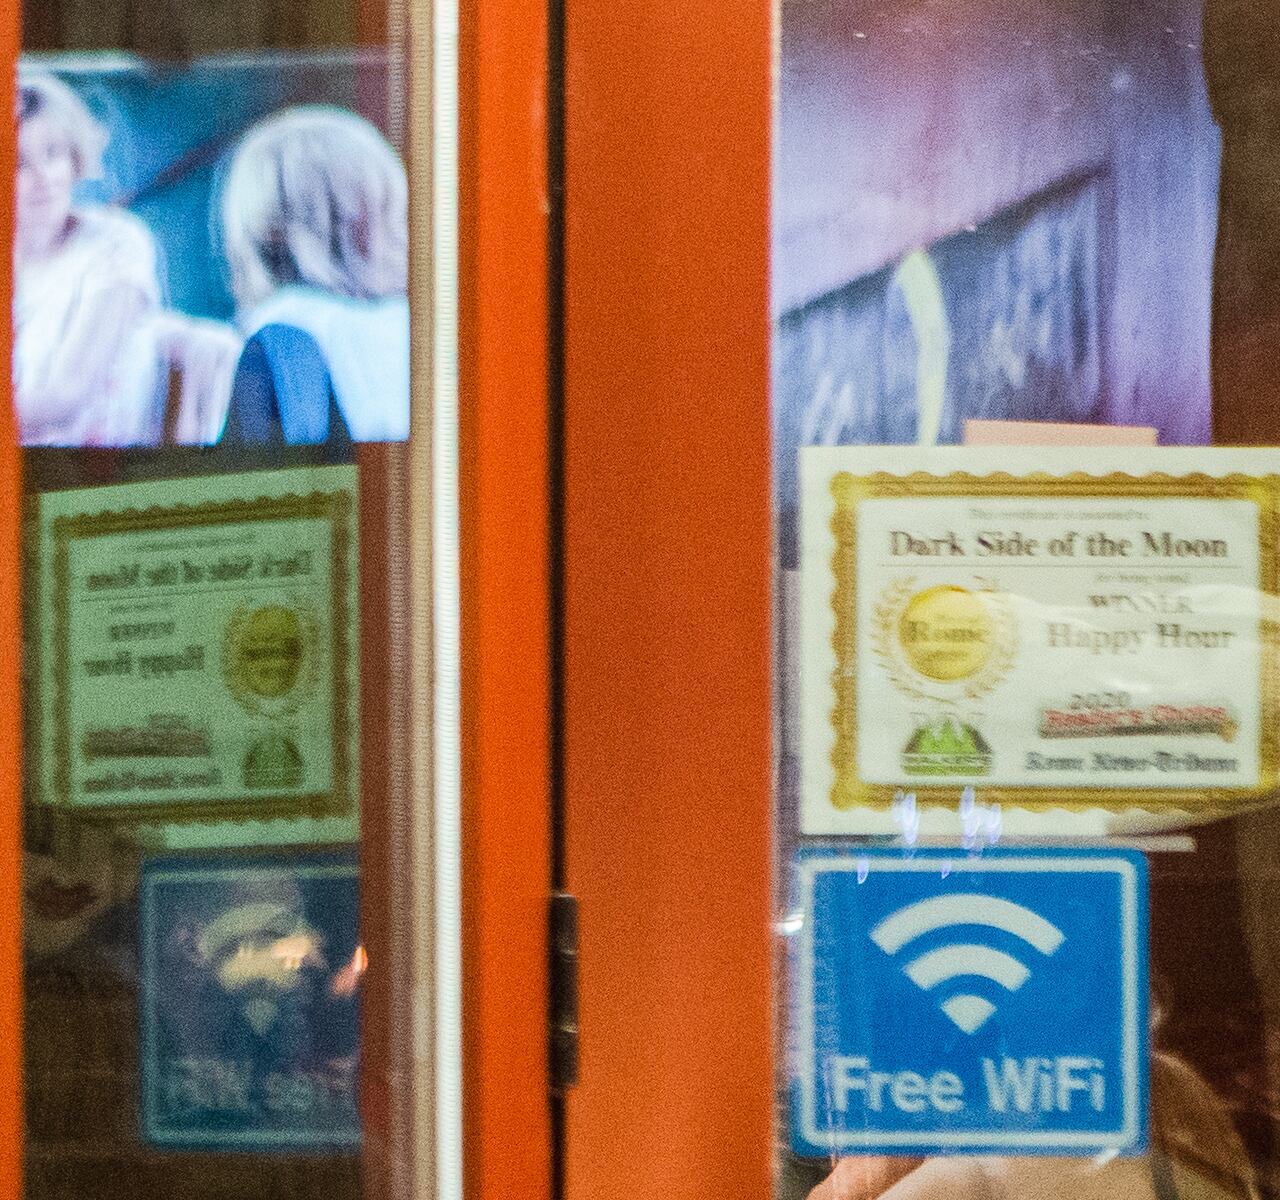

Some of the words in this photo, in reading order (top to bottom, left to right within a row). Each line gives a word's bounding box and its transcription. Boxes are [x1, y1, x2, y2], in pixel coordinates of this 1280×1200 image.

[890, 530, 966, 557] Dark
[976, 530, 1040, 557] Side
[1047, 530, 1079, 557] of
[1085, 530, 1133, 557] the
[1140, 531, 1228, 557] Moon
[1046, 622, 1148, 655] Happy
[1155, 622, 1237, 649] Hour
[830, 1055, 965, 1113] Free
[981, 1055, 1105, 1113] WiFi
